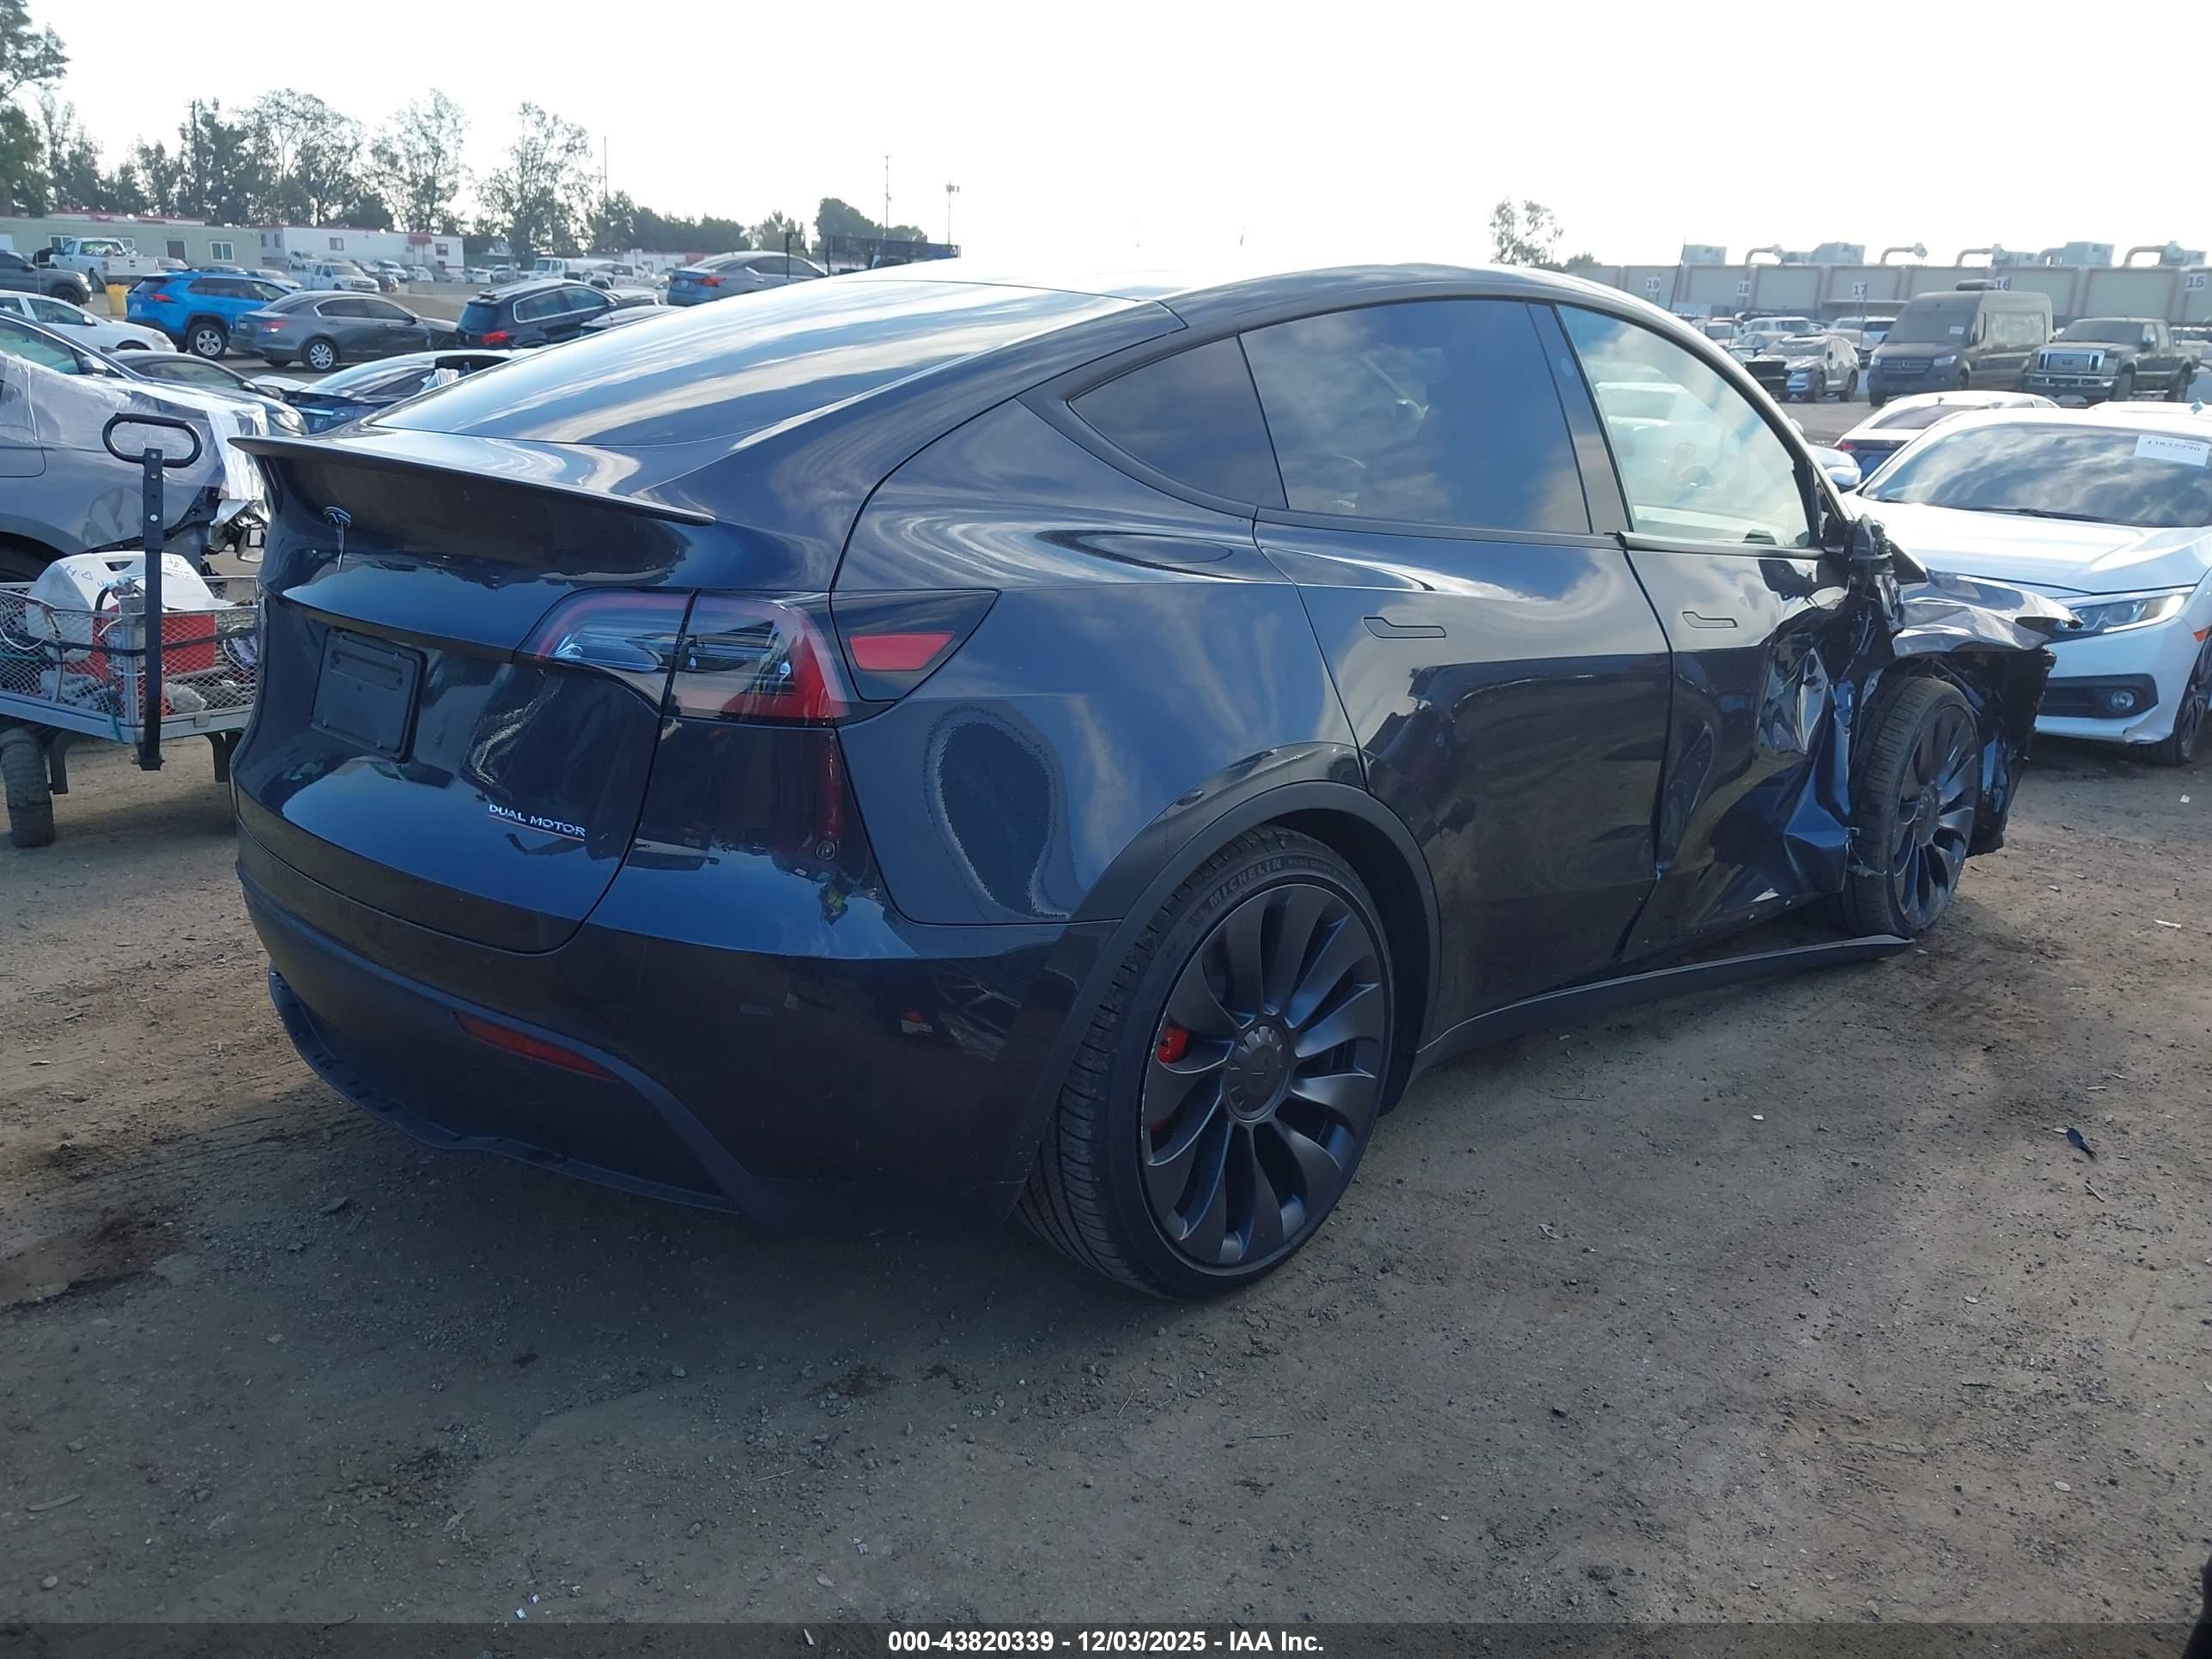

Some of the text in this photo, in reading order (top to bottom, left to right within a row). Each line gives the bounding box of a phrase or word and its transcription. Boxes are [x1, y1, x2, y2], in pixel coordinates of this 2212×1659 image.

[1647, 278, 1659, 289] 19
[2187, 276, 2205, 289] 15
[1854, 284, 1867, 295] 17
[489, 804, 586, 837] DUAL MOTOR
[1208, 858, 1283, 908] MICHELIN
